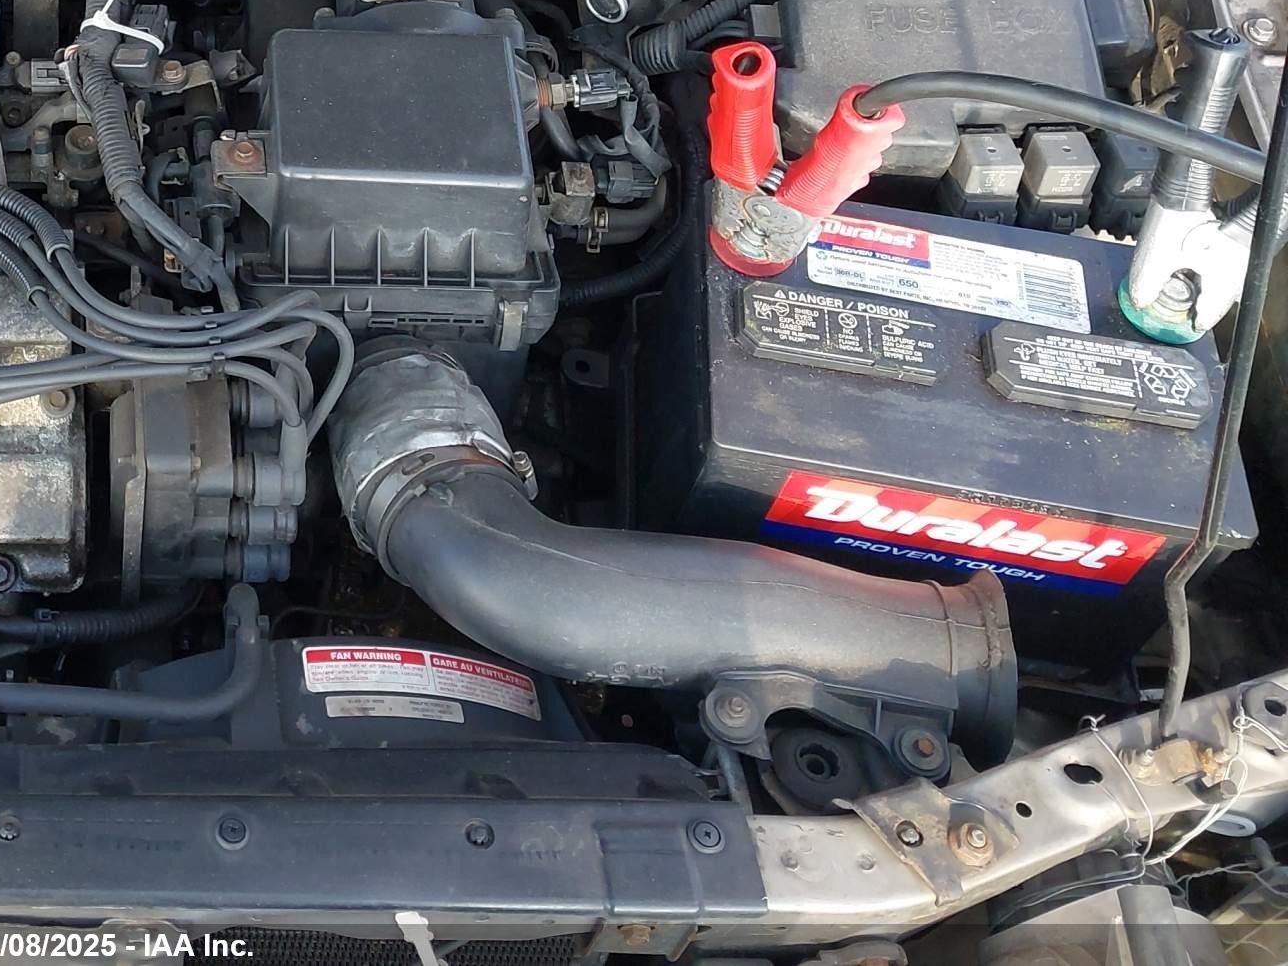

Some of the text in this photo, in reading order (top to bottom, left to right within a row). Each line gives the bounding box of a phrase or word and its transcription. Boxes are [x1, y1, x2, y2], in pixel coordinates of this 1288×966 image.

[864, 6, 958, 34] FUSE
[820, 219, 917, 250] Duralast
[833, 245, 910, 264] PROVEN TOUGH
[898, 278, 919, 289] 650
[788, 290, 910, 319] DANGER / POISON
[794, 307, 819, 318] SHIELD
[778, 316, 817, 329] EXPLOSIVE
[778, 322, 804, 332] GASES
[882, 335, 935, 350] SULFURIC ACID
[805, 485, 1127, 570] Duralast
[835, 536, 1046, 583] PROVEN TOUGH
[330, 651, 402, 662] FAN WARNING
[460, 662, 474, 671] AU
